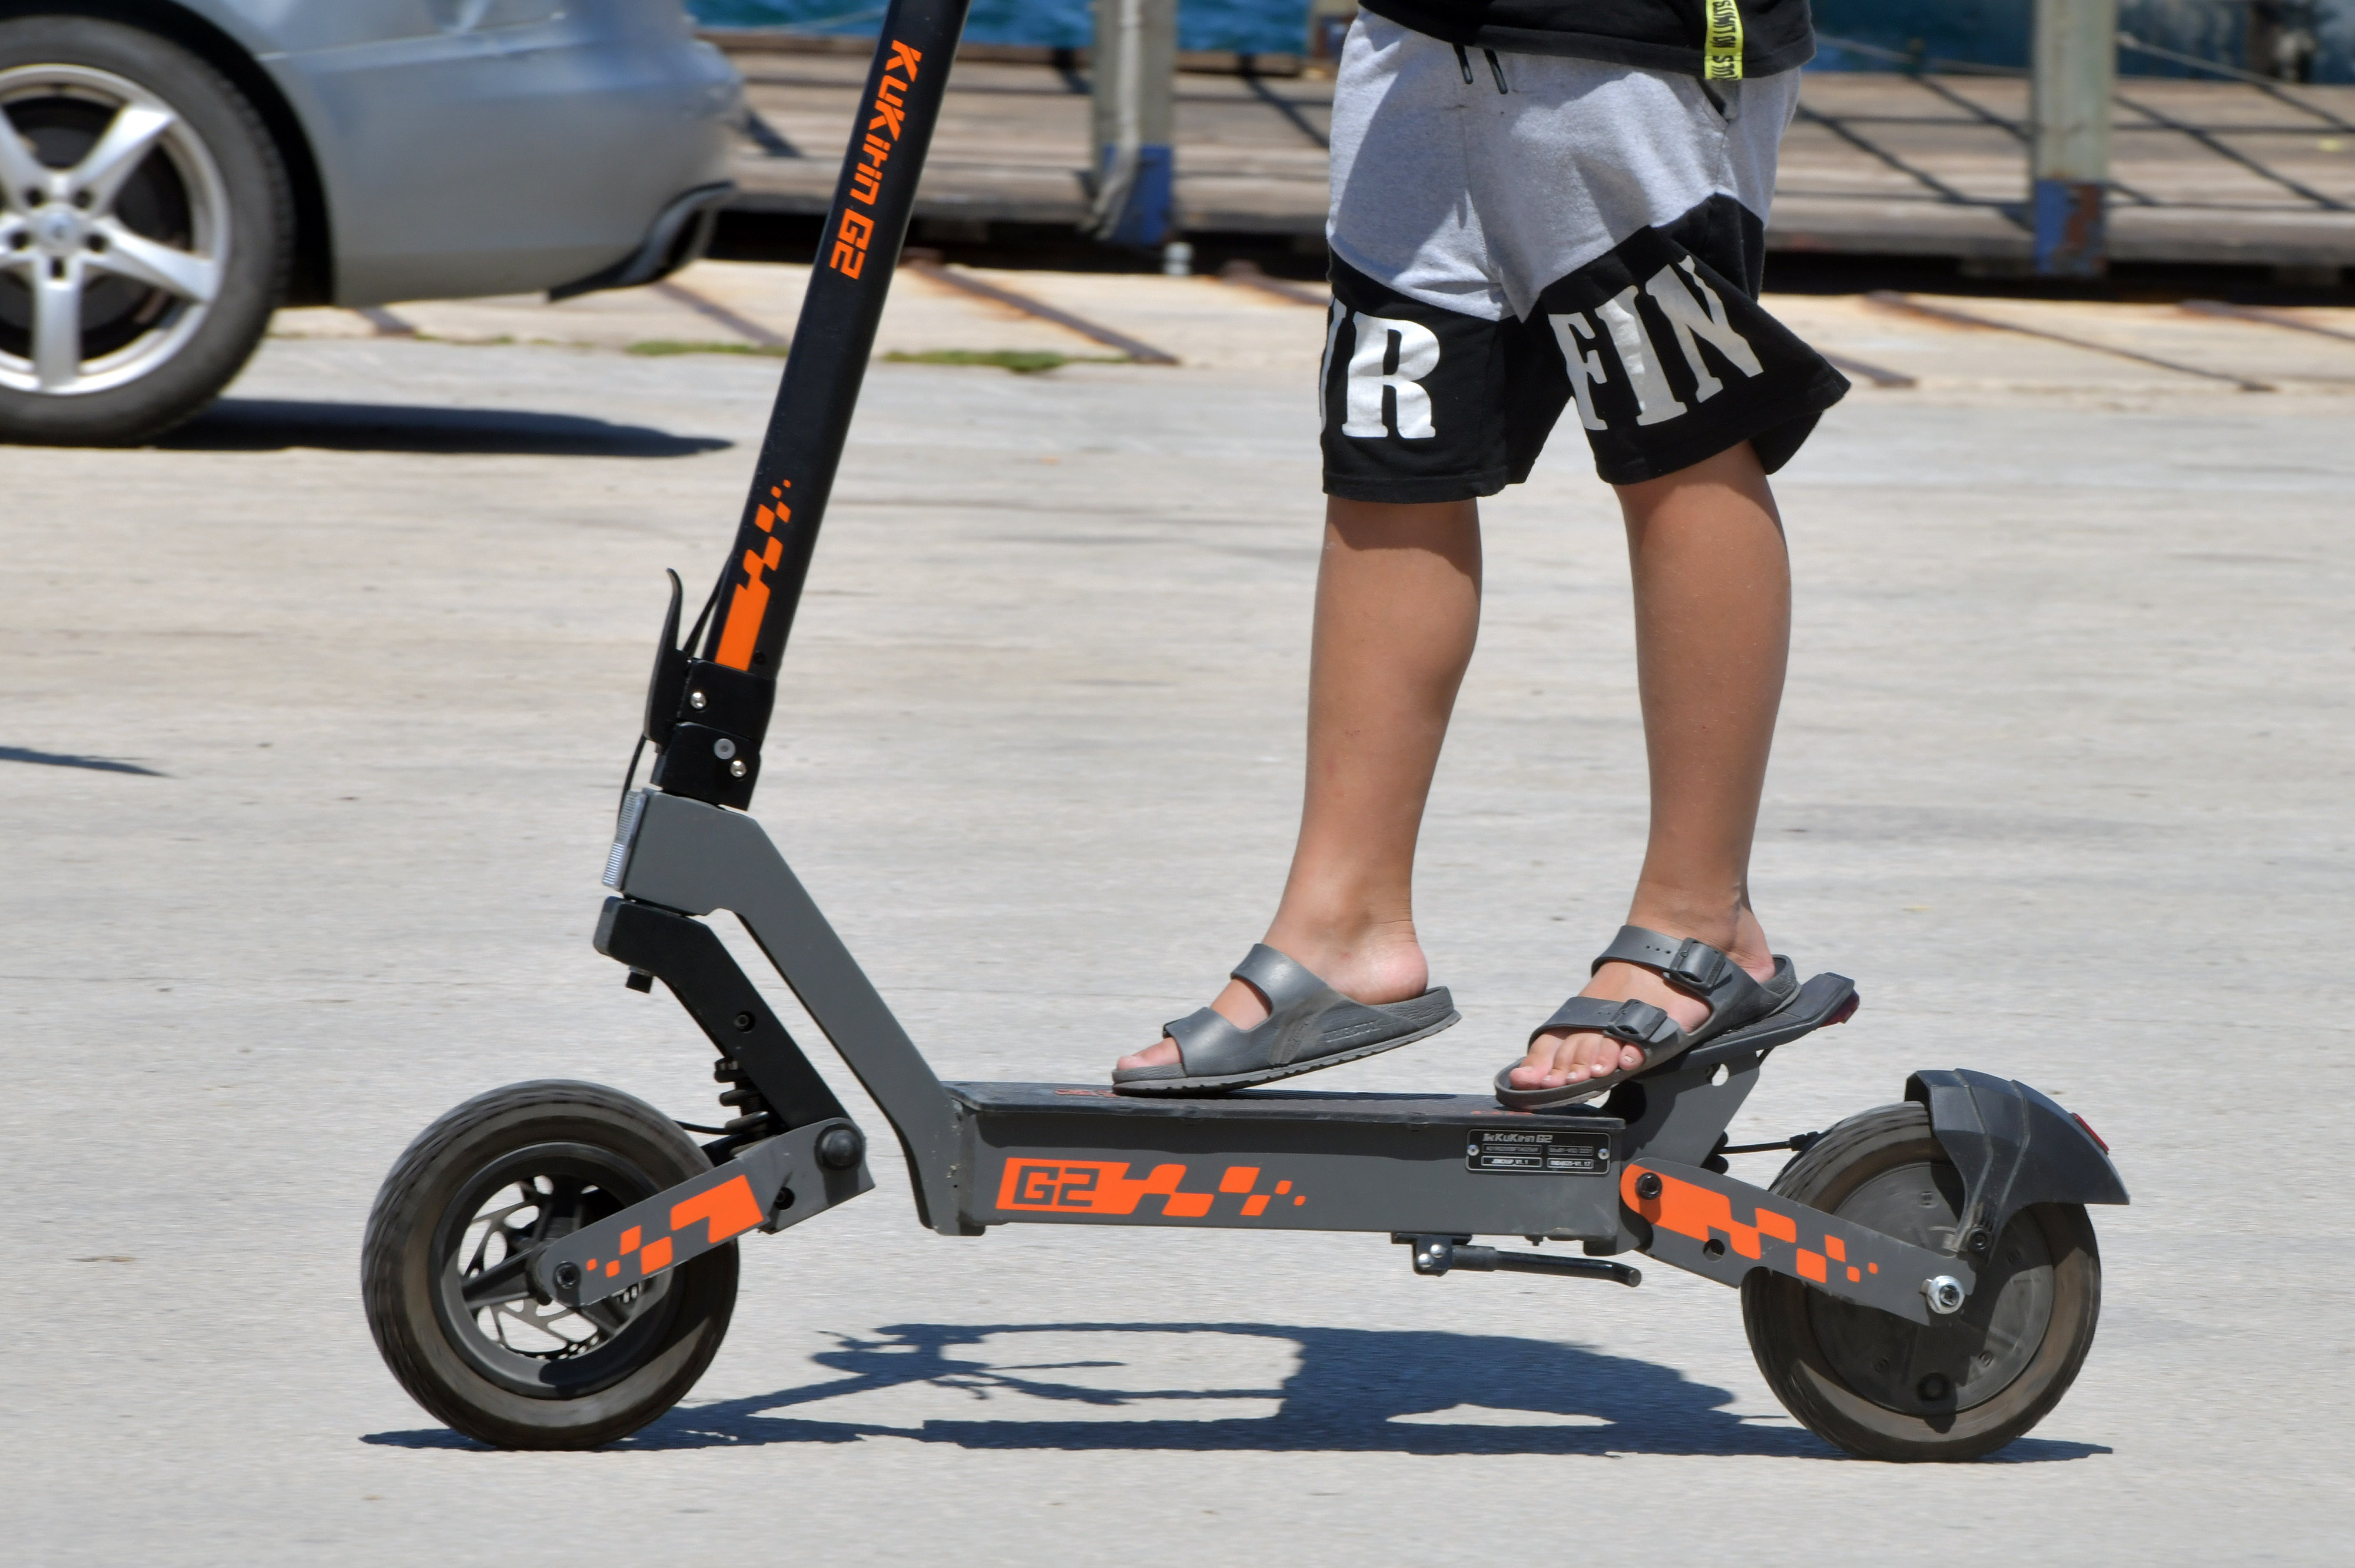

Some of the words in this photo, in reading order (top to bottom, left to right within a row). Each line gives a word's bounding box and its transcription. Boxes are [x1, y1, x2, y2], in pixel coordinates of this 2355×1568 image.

[1712, 0, 1736, 33] LIMITS
[1710, 35, 1736, 48] NO
[829, 208, 875, 280] G2
[1535, 1134, 1553, 1143] G2
[1012, 1165, 1100, 1207] G2
